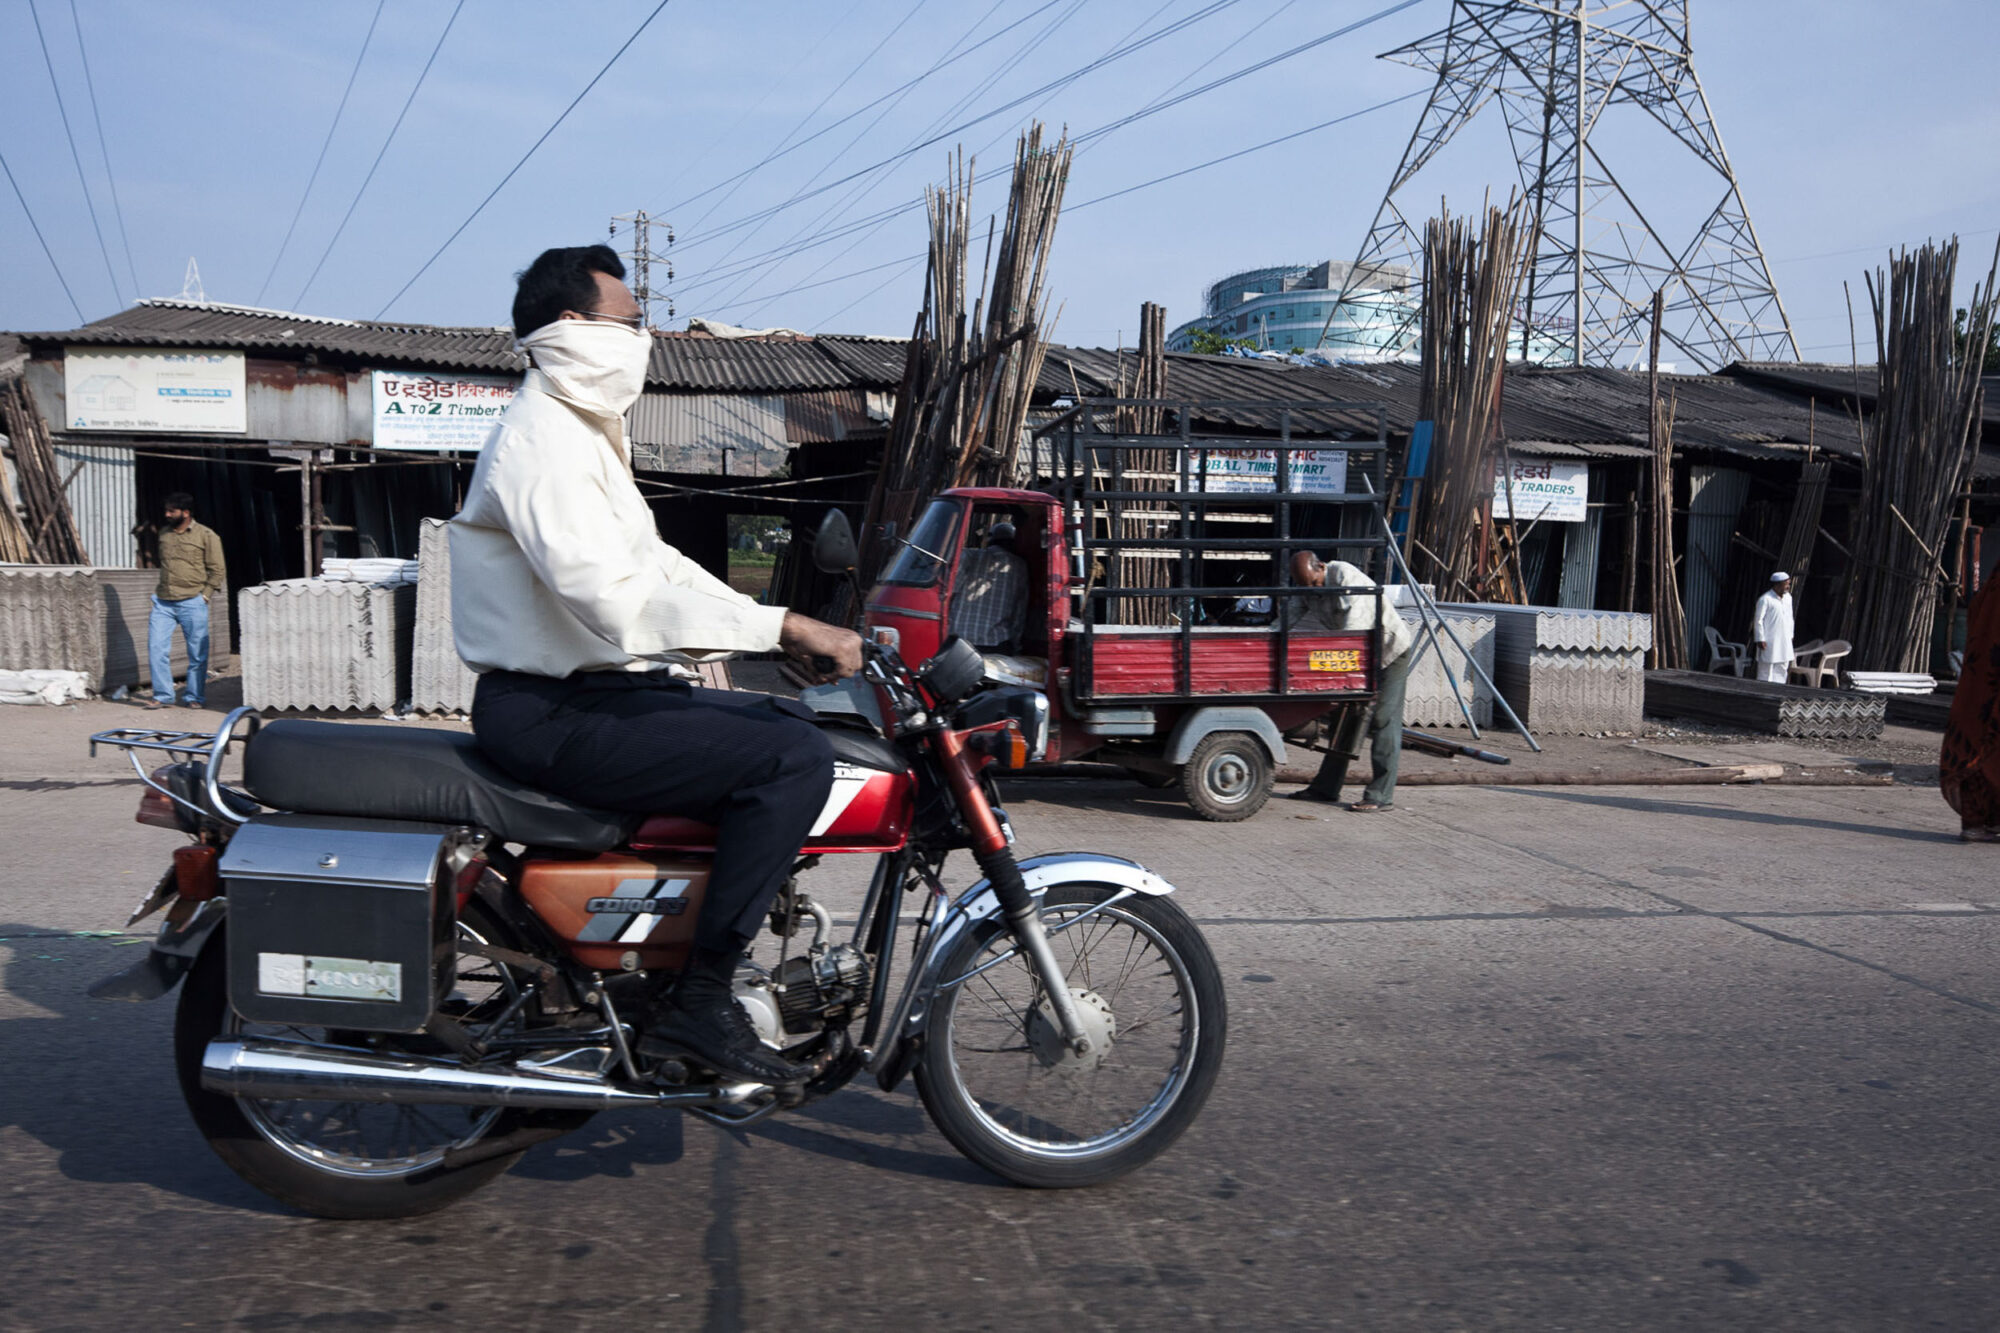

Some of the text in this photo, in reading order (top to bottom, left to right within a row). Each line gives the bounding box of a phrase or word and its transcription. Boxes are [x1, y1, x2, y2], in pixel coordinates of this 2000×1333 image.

[382, 380, 400, 397] ए
[384, 401, 406, 414] A
[448, 403, 498, 416] Timber
[1248, 461, 1293, 473] TIMBR
[1294, 464, 1327, 475] MART
[1521, 481, 1576, 496] TRADERS
